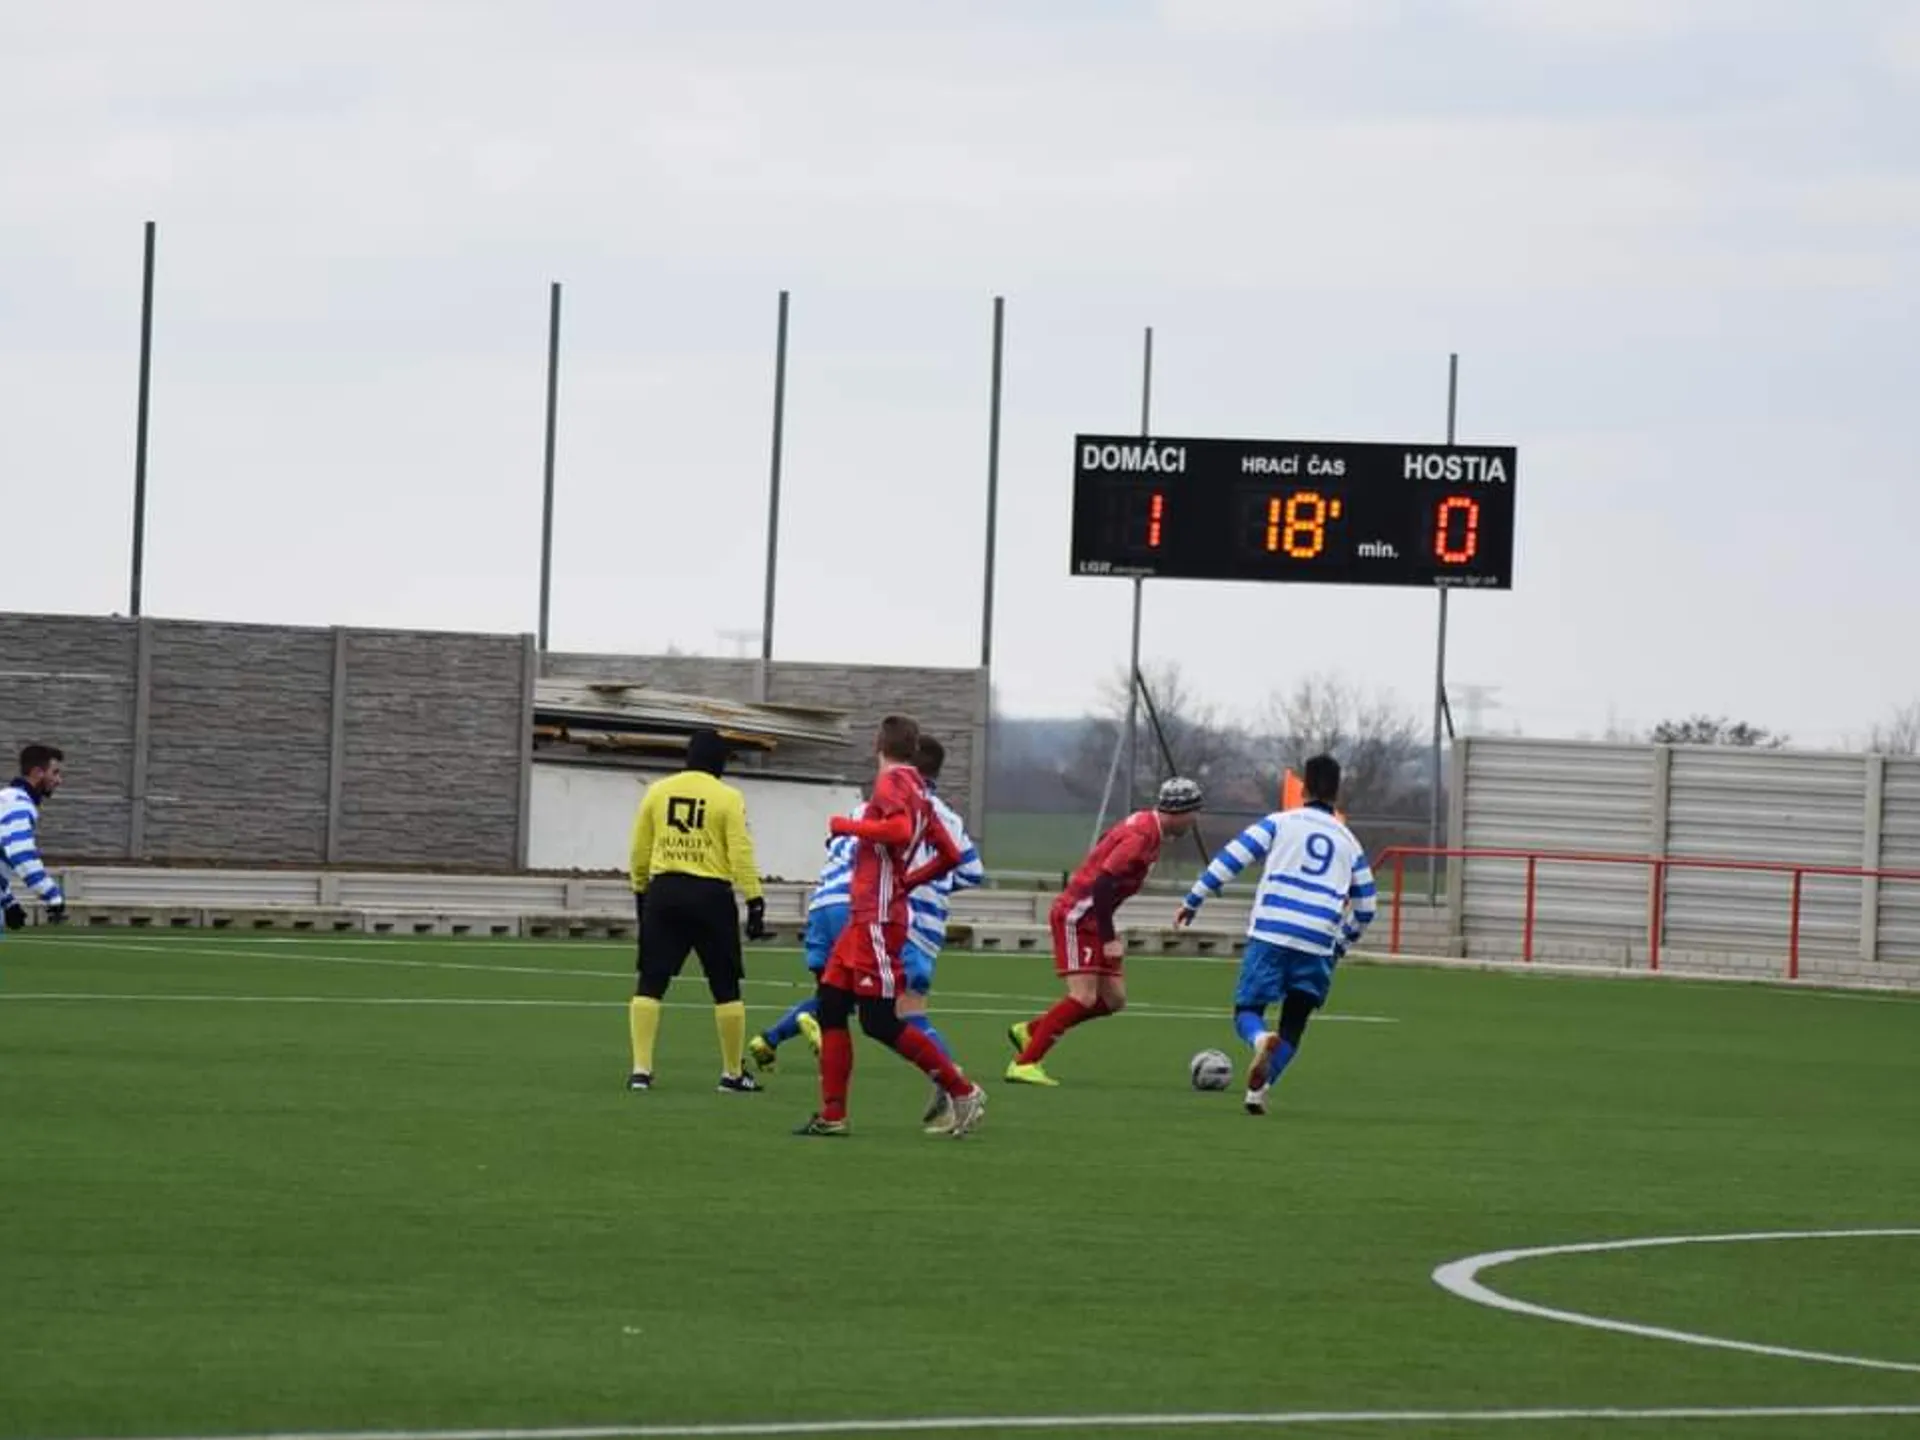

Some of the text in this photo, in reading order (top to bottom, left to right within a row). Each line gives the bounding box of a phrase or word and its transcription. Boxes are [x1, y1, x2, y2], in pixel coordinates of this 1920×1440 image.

[1082, 440, 1187, 473] DOMÁCI
[1241, 454, 1346, 476] HRACÍ ČAS
[1403, 453, 1507, 484] HOSTIA
[1149, 494, 1163, 547] 1
[1435, 496, 1479, 563] 0
[1357, 539, 1400, 559] min.
[667, 796, 706, 834] Qi
[1300, 831, 1336, 877] 9
